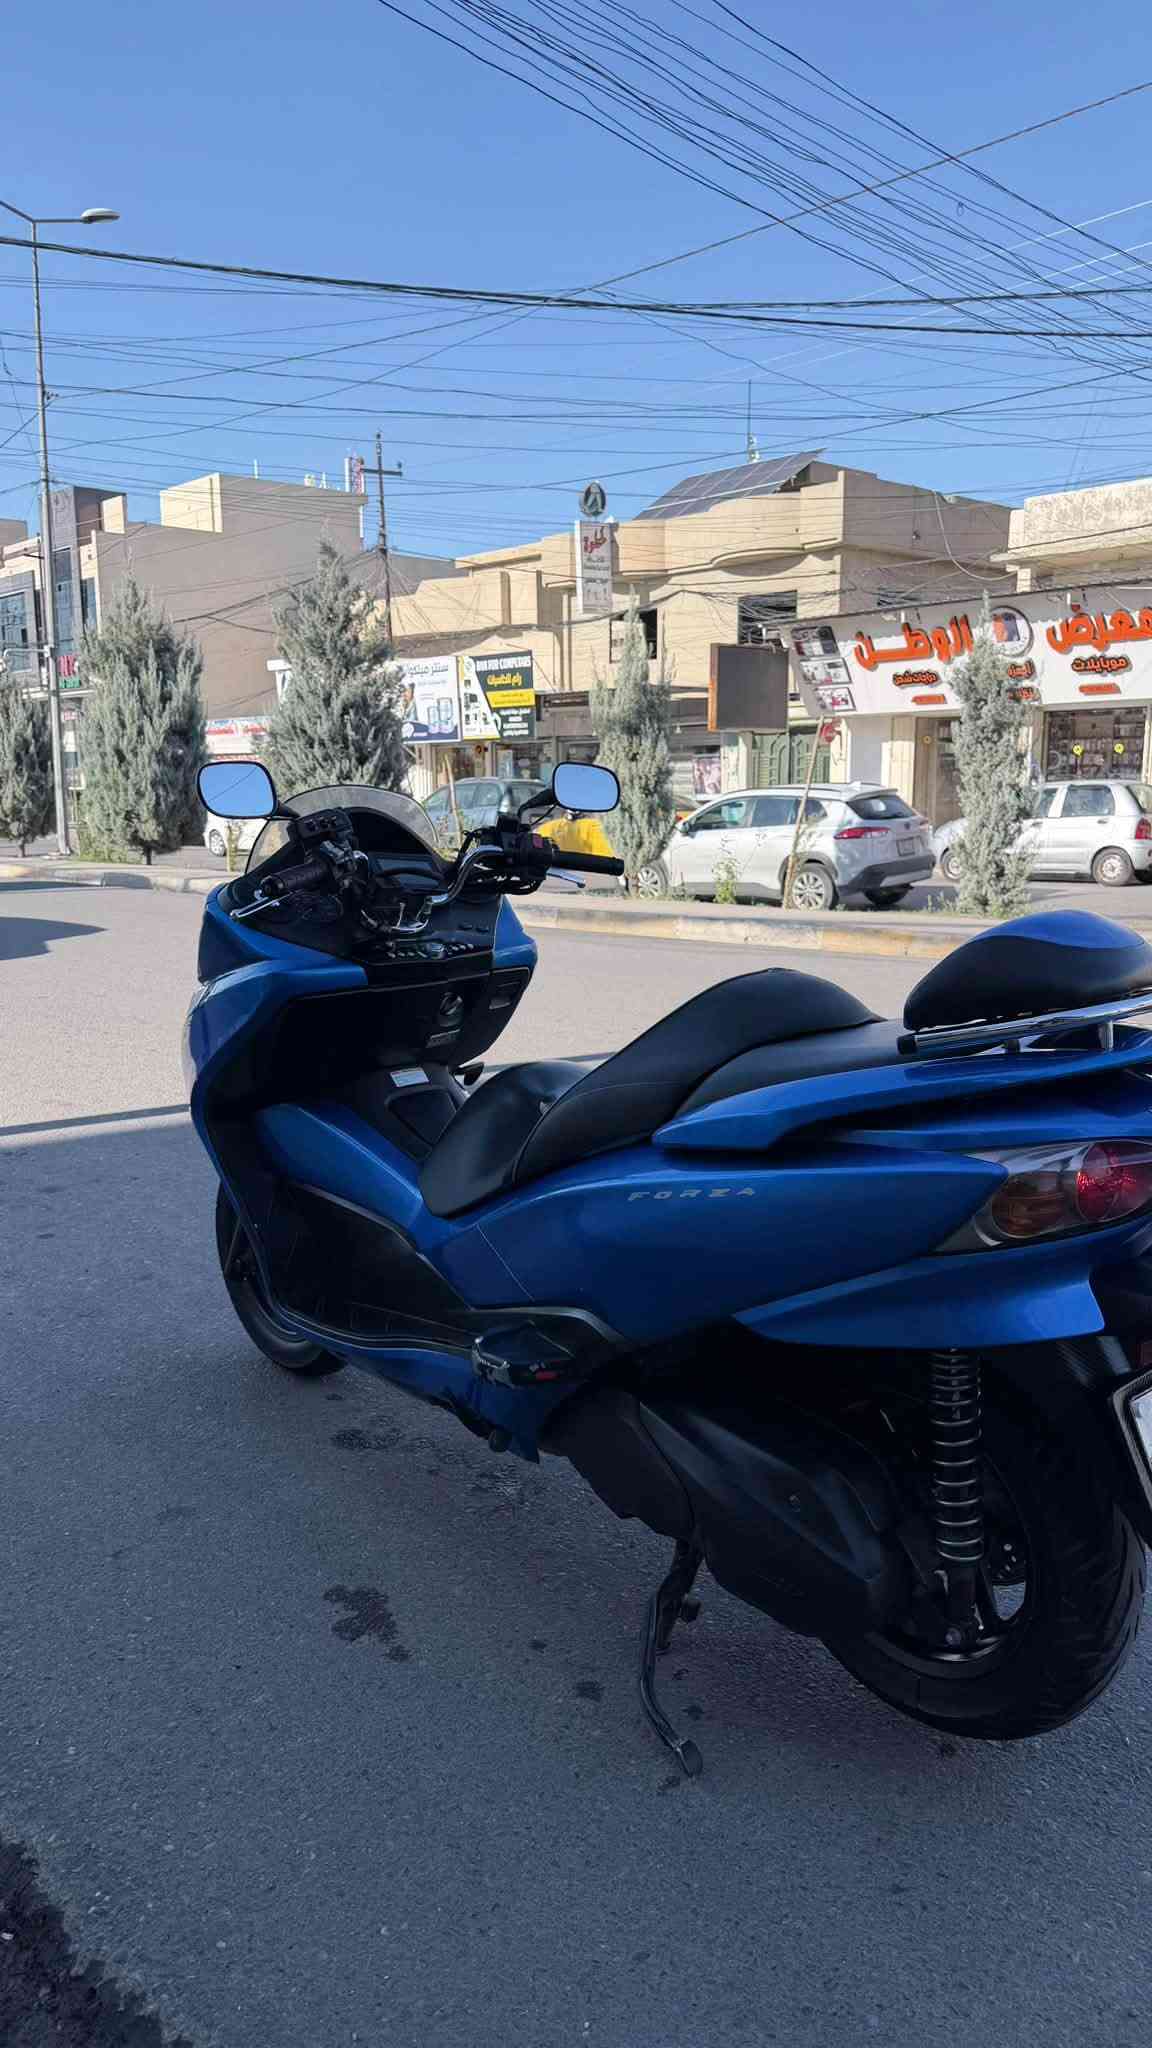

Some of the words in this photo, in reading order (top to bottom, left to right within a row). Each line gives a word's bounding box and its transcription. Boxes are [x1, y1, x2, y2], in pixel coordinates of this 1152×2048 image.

[854, 614, 973, 671] الوطن
[1046, 605, 1152, 653] معرض
[1071, 655, 1131, 674] موبايلات
[627, 1187, 756, 1201] FORZA
